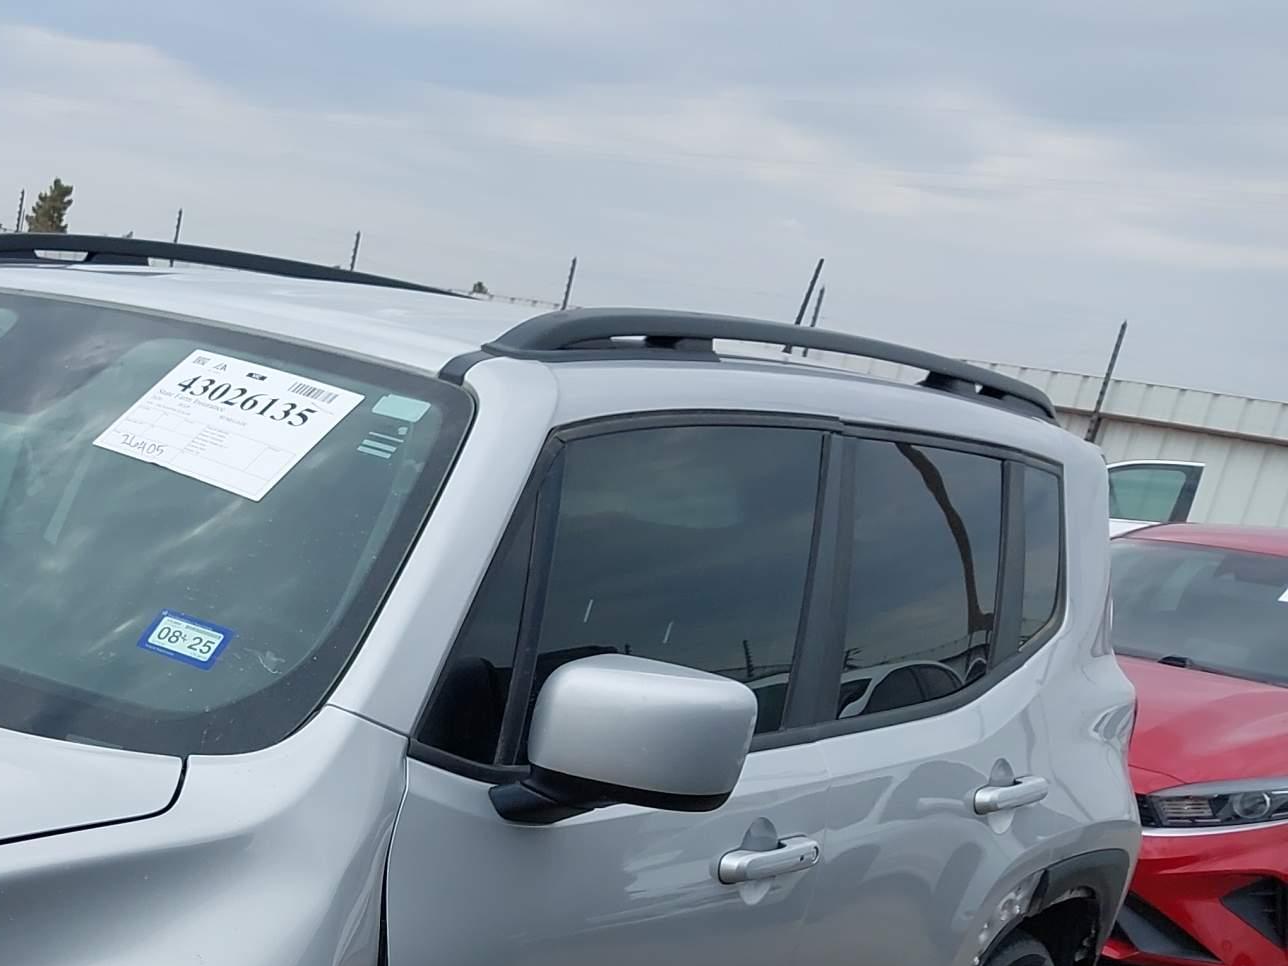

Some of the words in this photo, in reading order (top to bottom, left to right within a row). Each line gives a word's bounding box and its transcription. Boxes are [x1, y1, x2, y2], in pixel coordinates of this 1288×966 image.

[177, 375, 318, 428] 43026135
[157, 626, 183, 644] 08
[187, 636, 216, 655] 25
